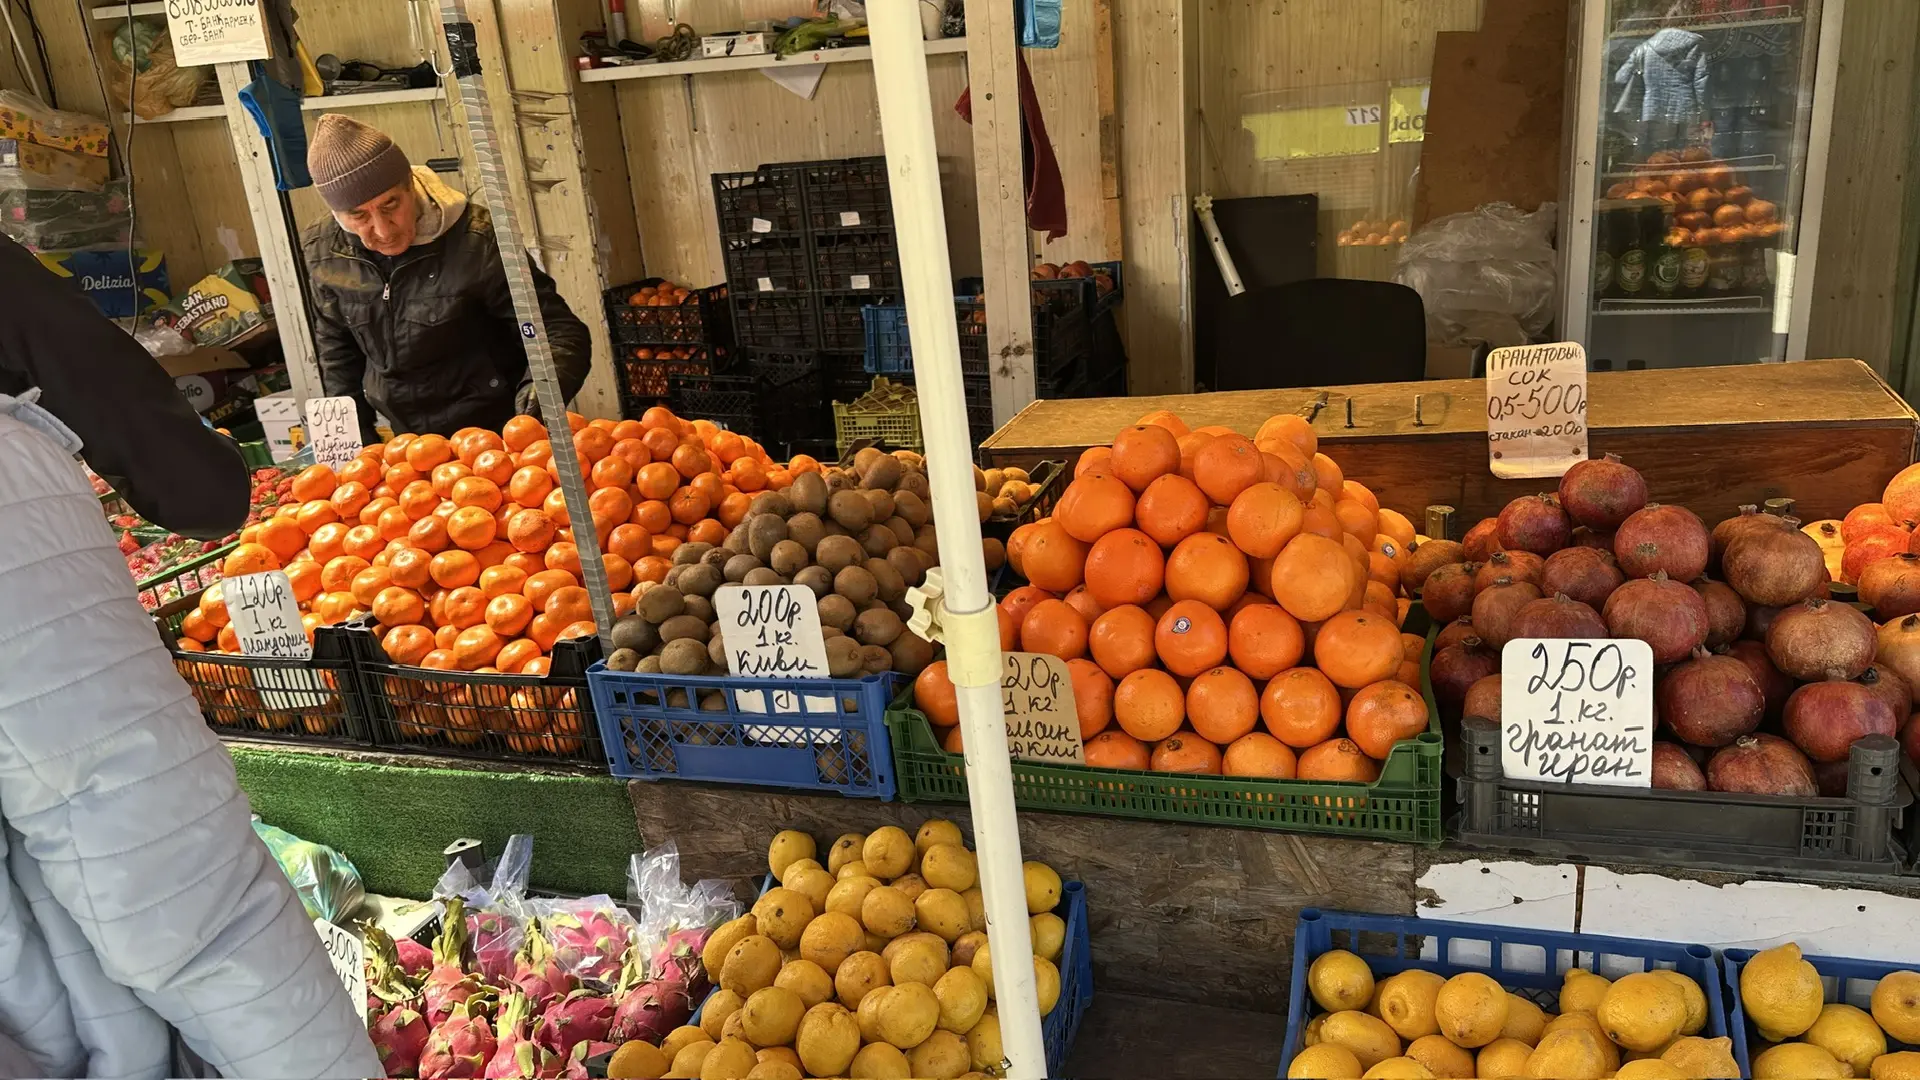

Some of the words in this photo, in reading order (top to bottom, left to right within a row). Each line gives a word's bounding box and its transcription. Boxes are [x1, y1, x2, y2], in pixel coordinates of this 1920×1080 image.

[81, 275, 133, 291] Delizia
[173, 295, 228, 334] SEBASTIANO
[182, 292, 204, 311] SAN
[523, 325, 535, 335] 51
[1508, 368, 1552, 386] СОК
[737, 587, 802, 629] 200р.
[1001, 655, 1065, 699] 20р.
[1528, 642, 1636, 699] 250р.
